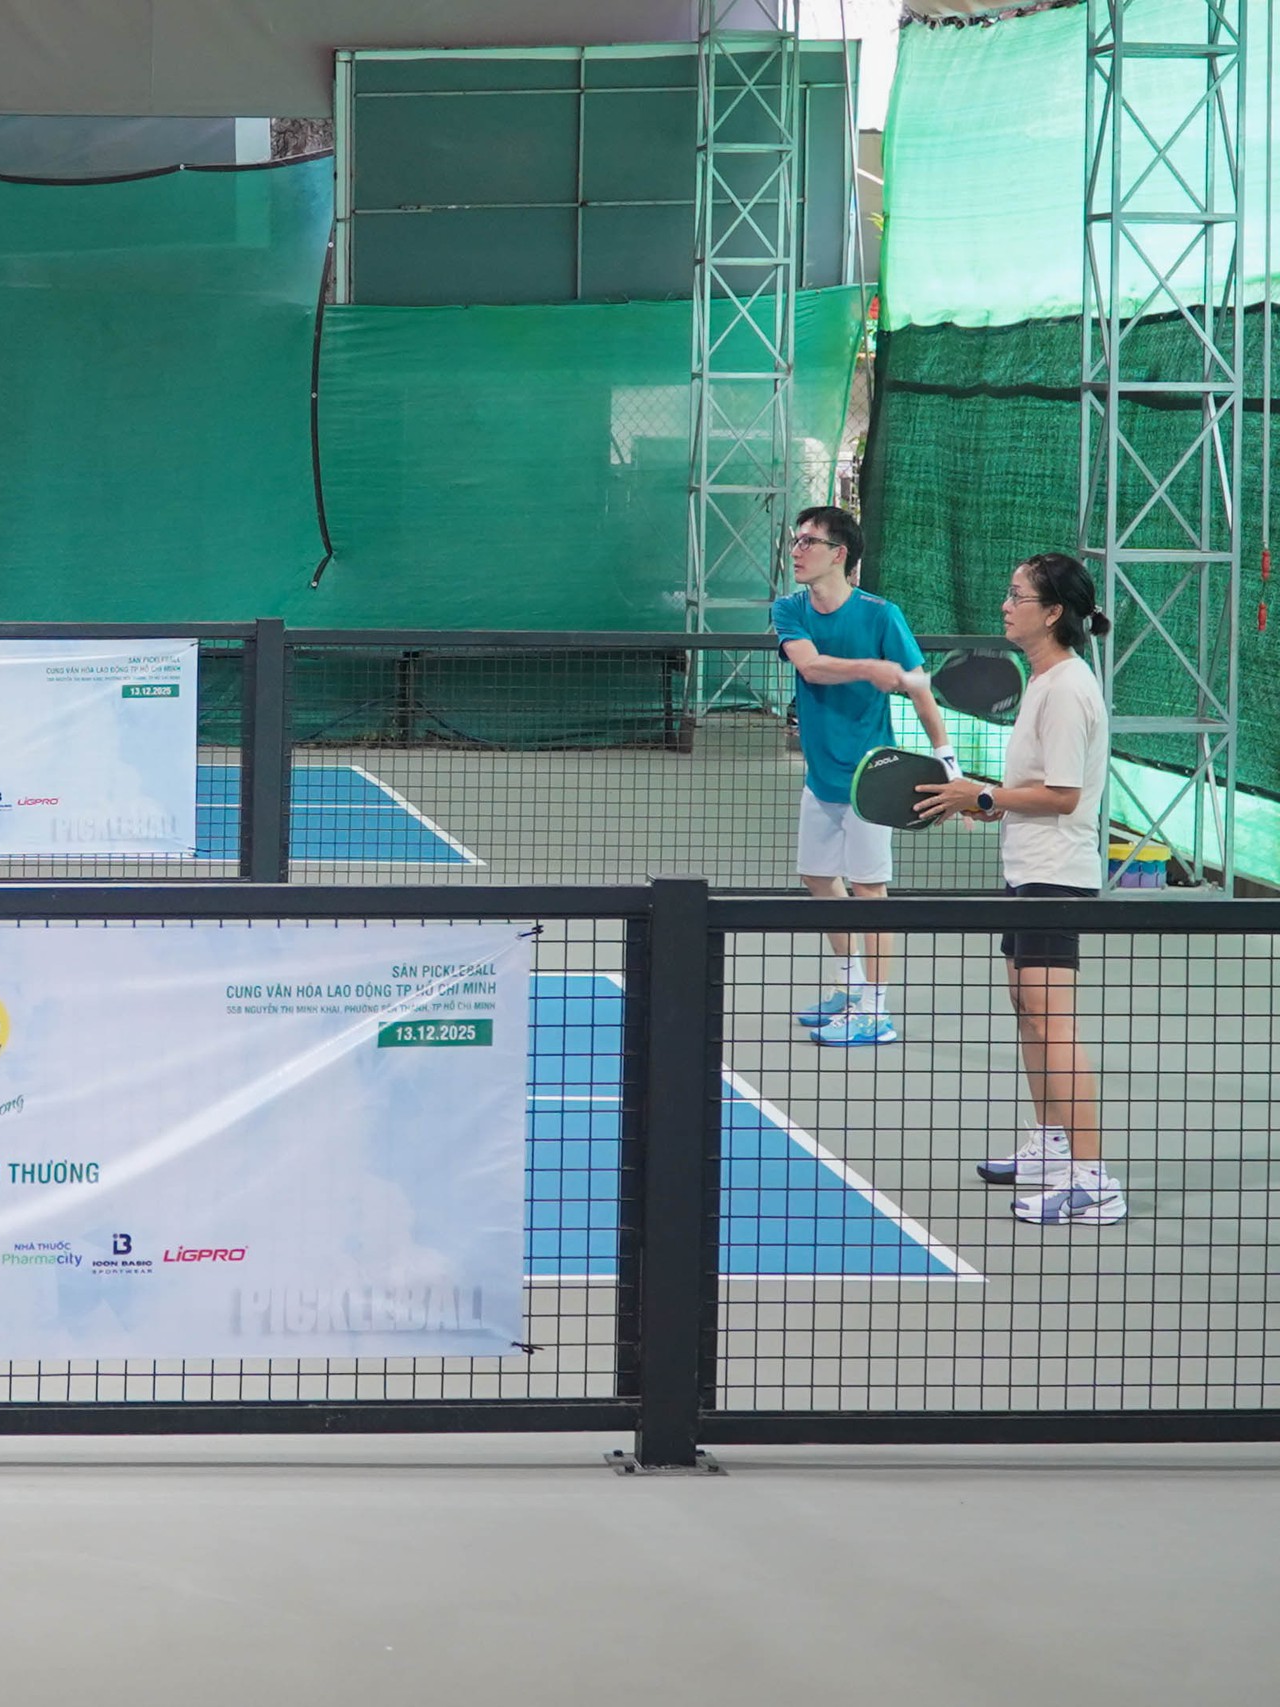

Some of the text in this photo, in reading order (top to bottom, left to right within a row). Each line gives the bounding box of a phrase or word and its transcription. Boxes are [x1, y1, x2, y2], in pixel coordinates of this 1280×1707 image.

[392, 962, 418, 978] SÂN
[226, 985, 262, 999] CUNG
[266, 983, 292, 998] VĂN
[296, 982, 322, 998] HÓA
[327, 984, 351, 998] LAO
[356, 981, 391, 1000] ĐỘNG
[396, 984, 412, 997] TP
[463, 982, 496, 995] MINH
[396, 1025, 476, 1042] 13.12.2025
[9, 1160, 100, 1184] THƯƠNG
[2, 1251, 83, 1267] Pharmacity
